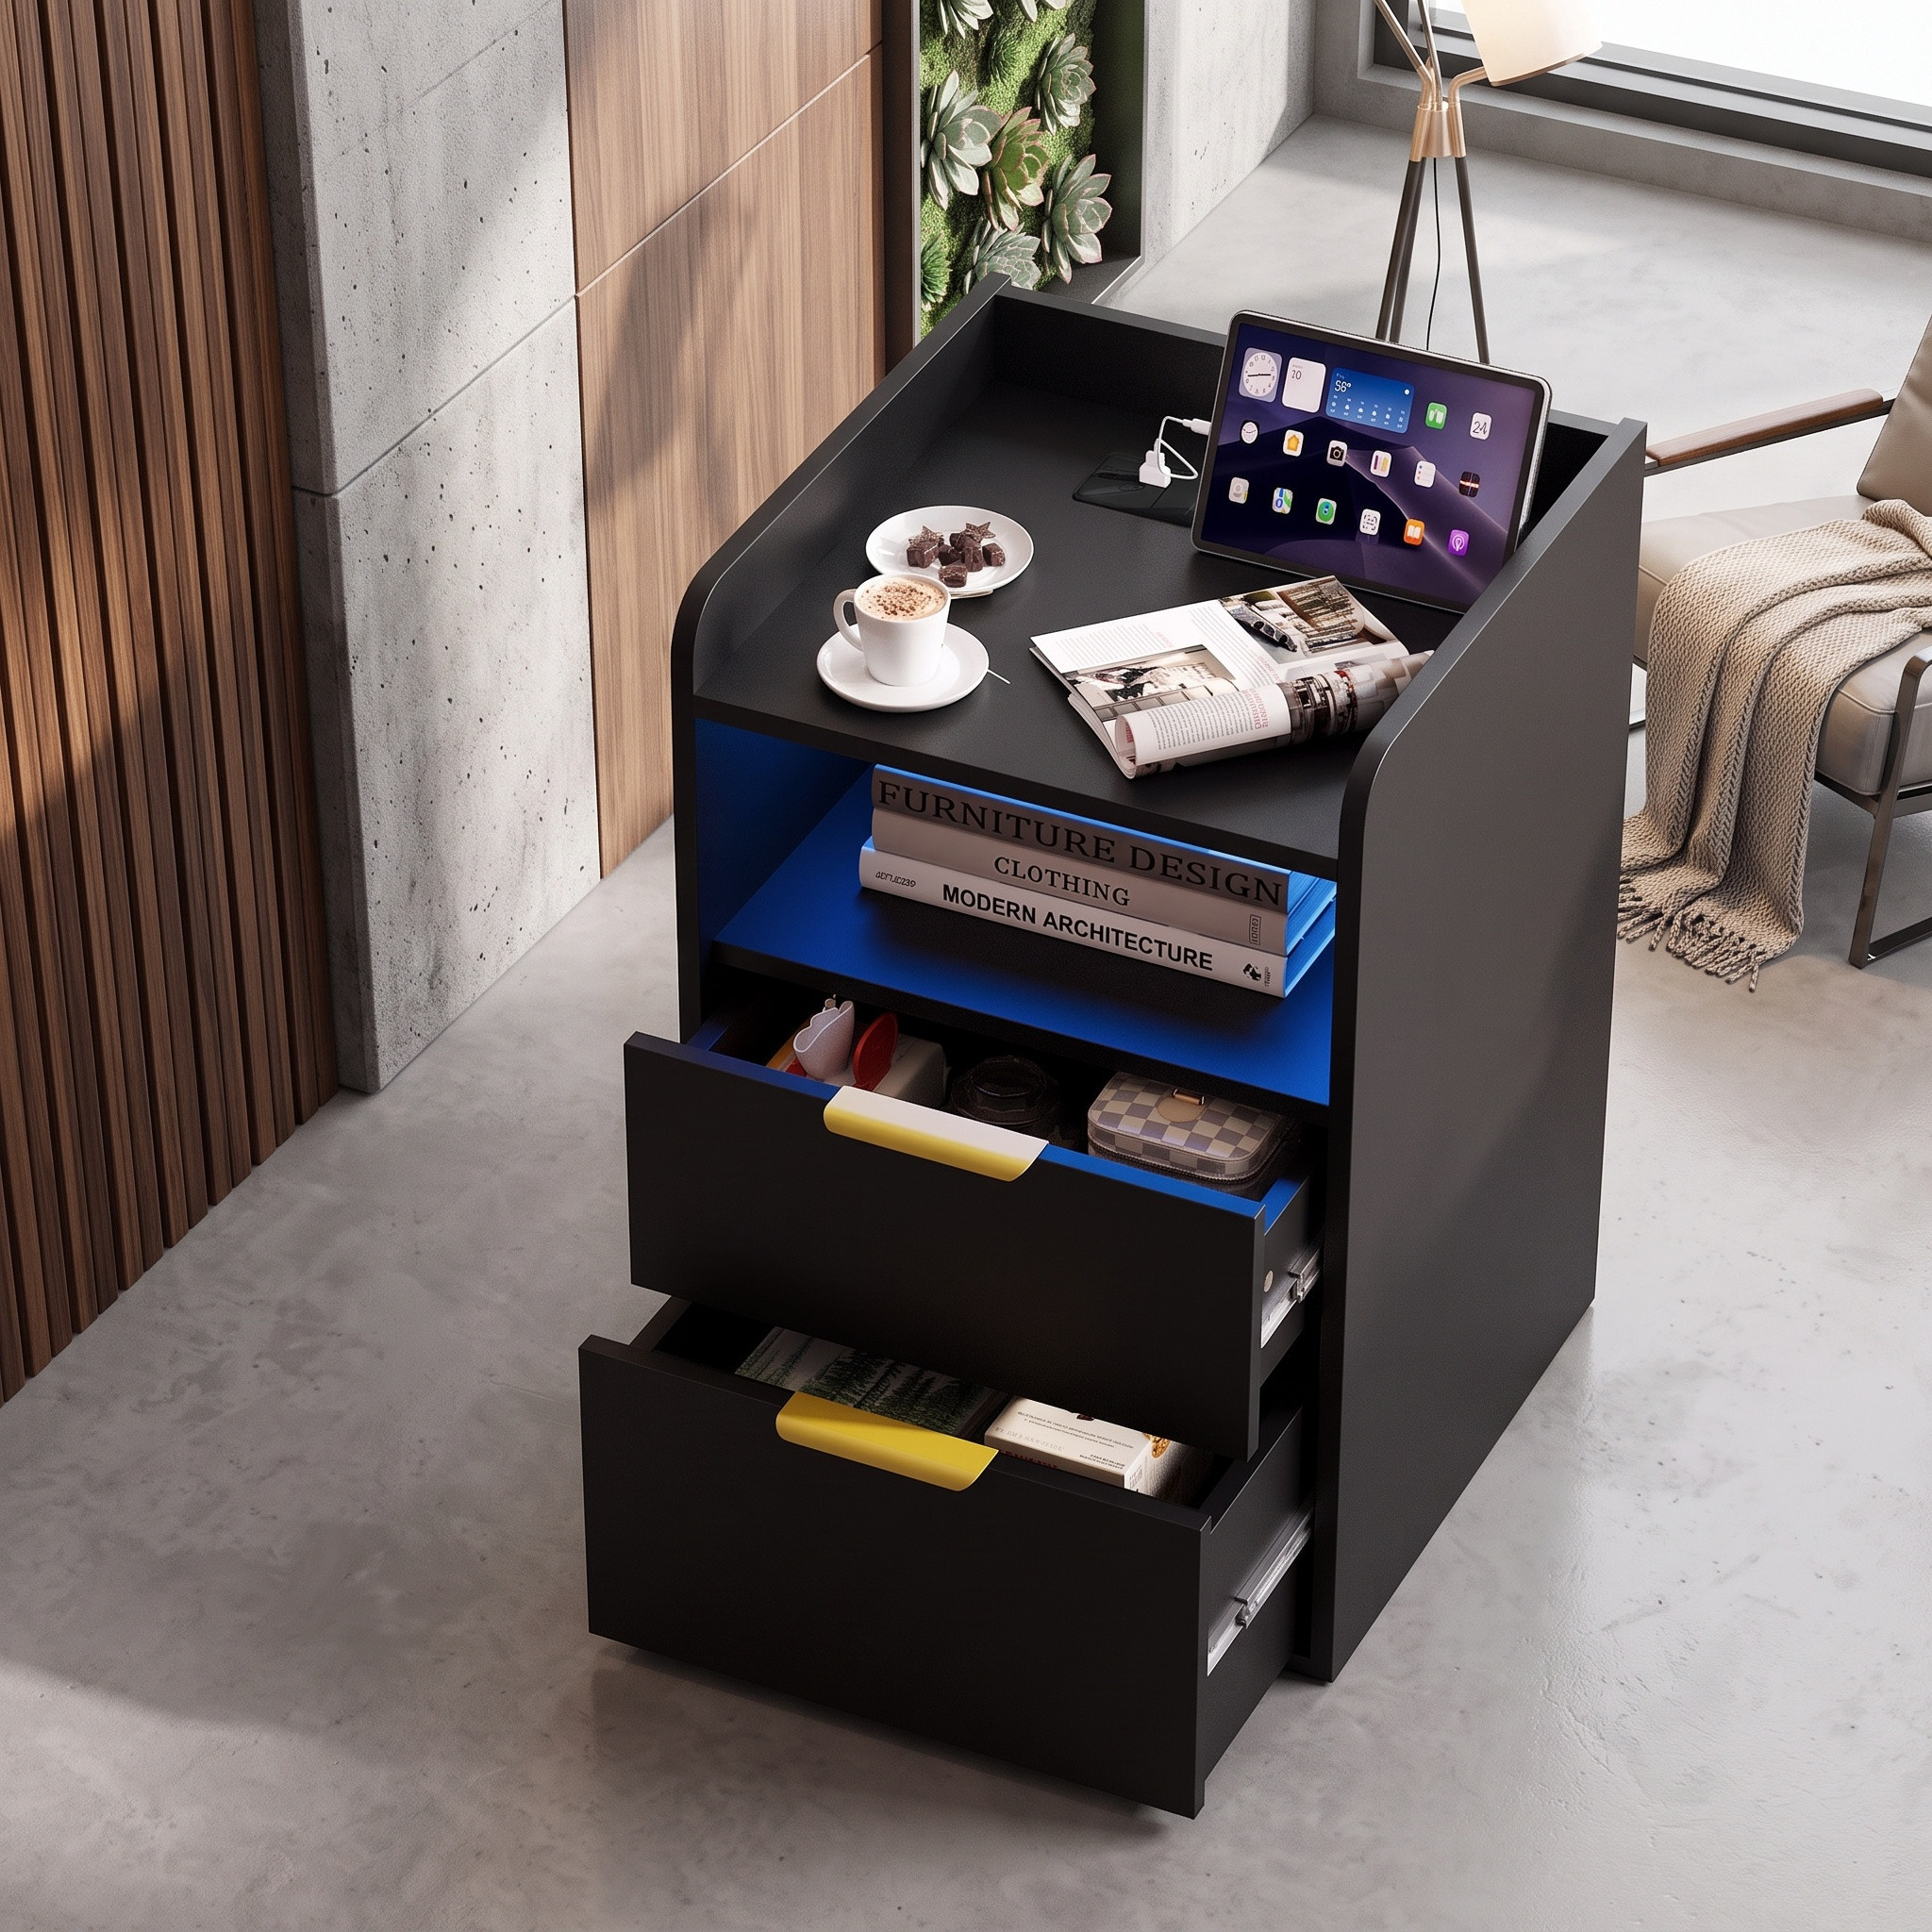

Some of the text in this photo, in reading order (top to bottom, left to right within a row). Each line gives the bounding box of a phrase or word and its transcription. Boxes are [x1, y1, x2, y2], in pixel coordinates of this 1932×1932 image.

[878, 780, 1282, 907] FURNITURE DESIGN
[993, 857, 1130, 907] CLOTHING
[942, 884, 1036, 924] MODERN
[1042, 911, 1213, 972] ARCHITECTURE
